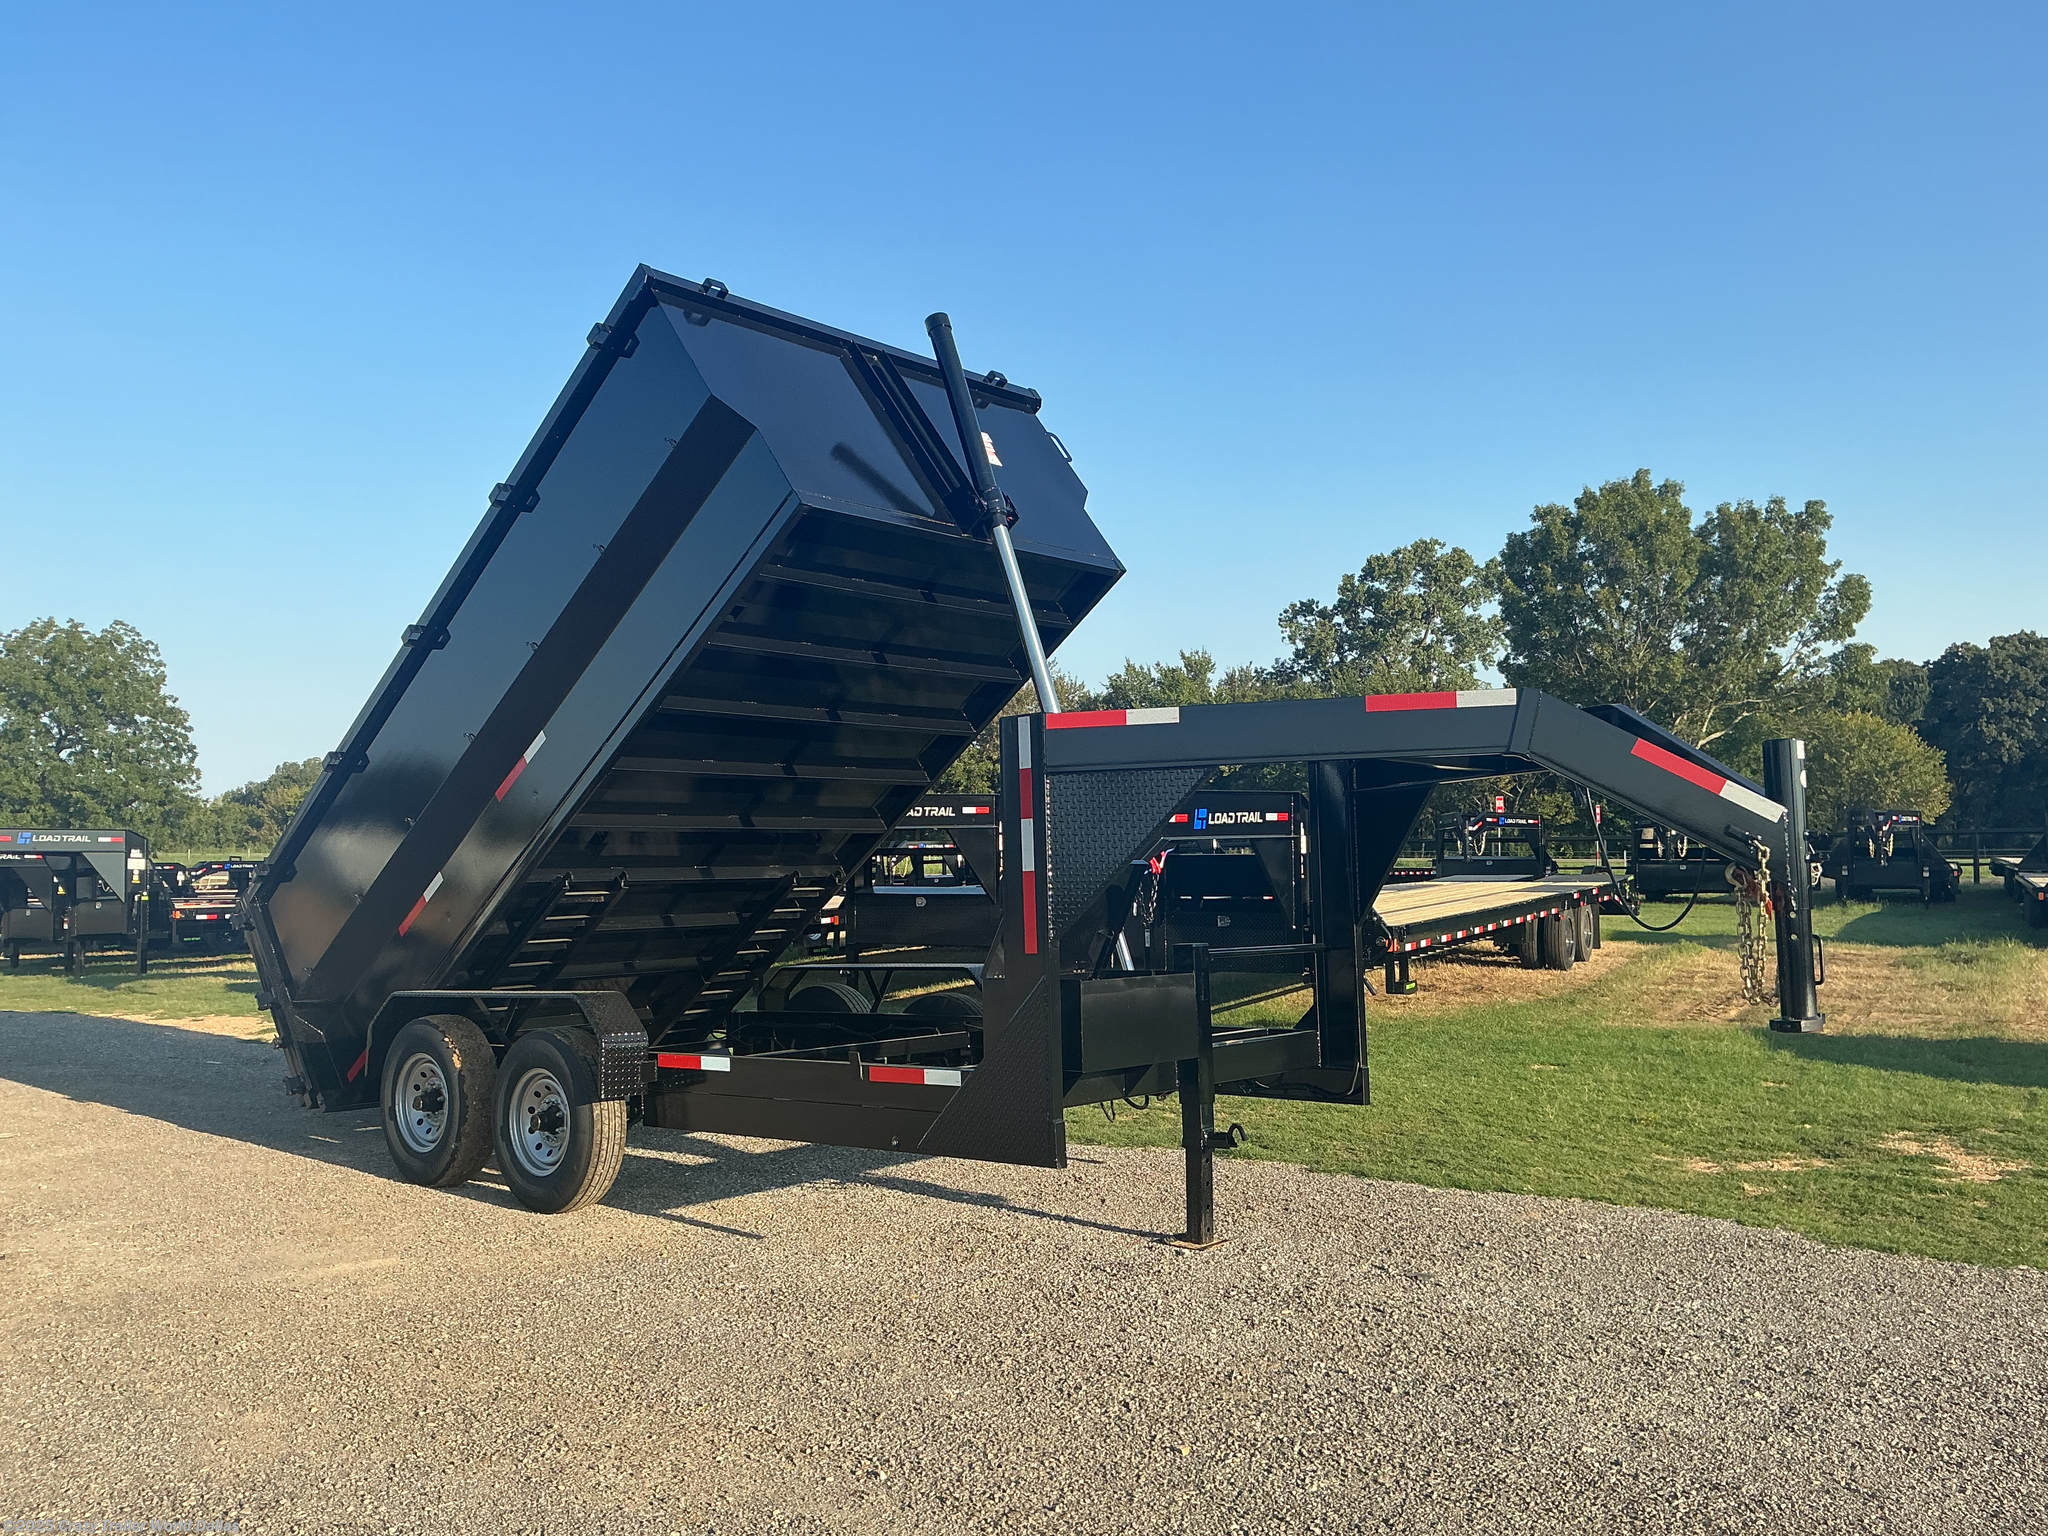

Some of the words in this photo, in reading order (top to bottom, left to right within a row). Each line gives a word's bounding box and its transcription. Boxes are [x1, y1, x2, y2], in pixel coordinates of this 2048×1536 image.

[924, 807, 956, 816] TRAIL
[1208, 812, 1235, 824] LOAD
[1235, 811, 1263, 823] TRAIL
[32, 834, 60, 842] LOAD
[62, 835, 91, 843] TRAIL
